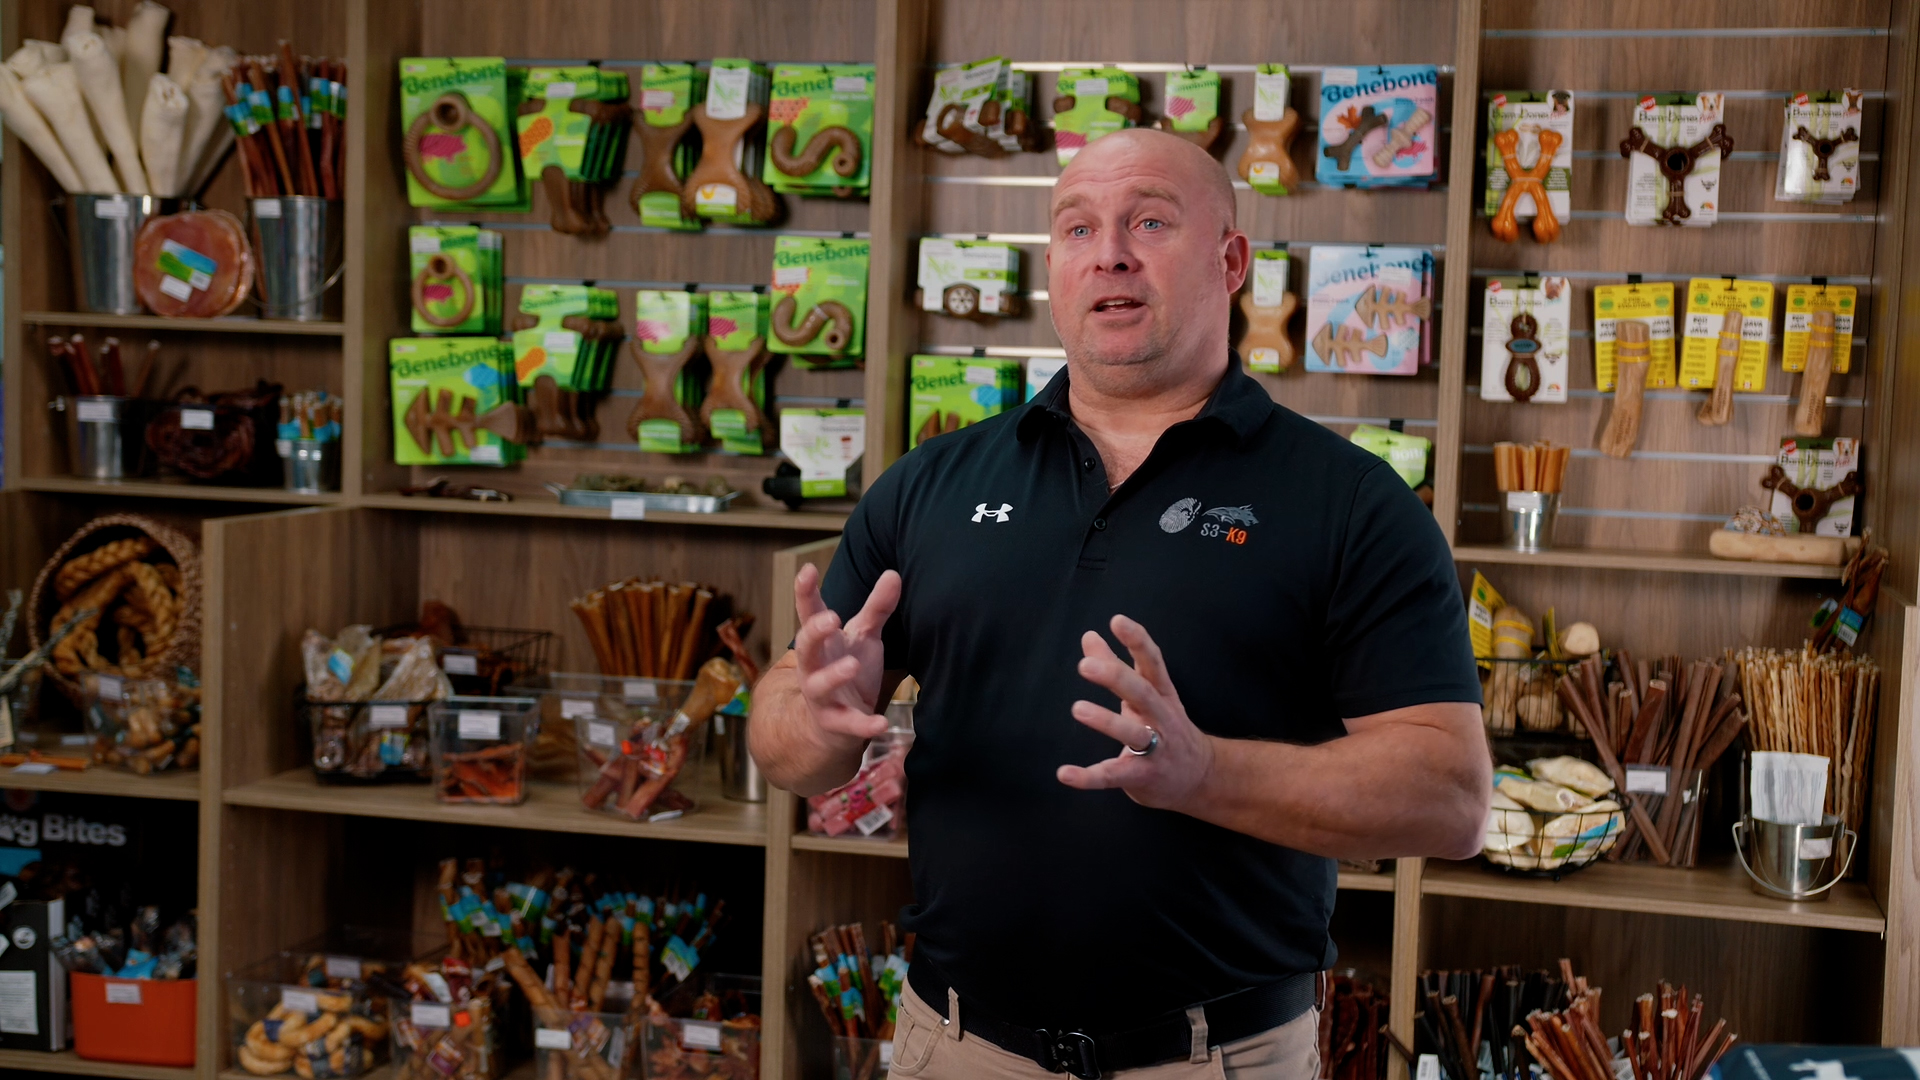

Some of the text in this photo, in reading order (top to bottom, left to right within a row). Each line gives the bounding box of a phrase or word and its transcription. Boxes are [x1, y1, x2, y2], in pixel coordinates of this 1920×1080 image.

[1321, 69, 1438, 103] Benebone
[777, 243, 870, 266] Benebone
[391, 344, 502, 379] Benebone
[1200, 522, 1248, 545] S3-K9
[42, 813, 127, 847] Bites
